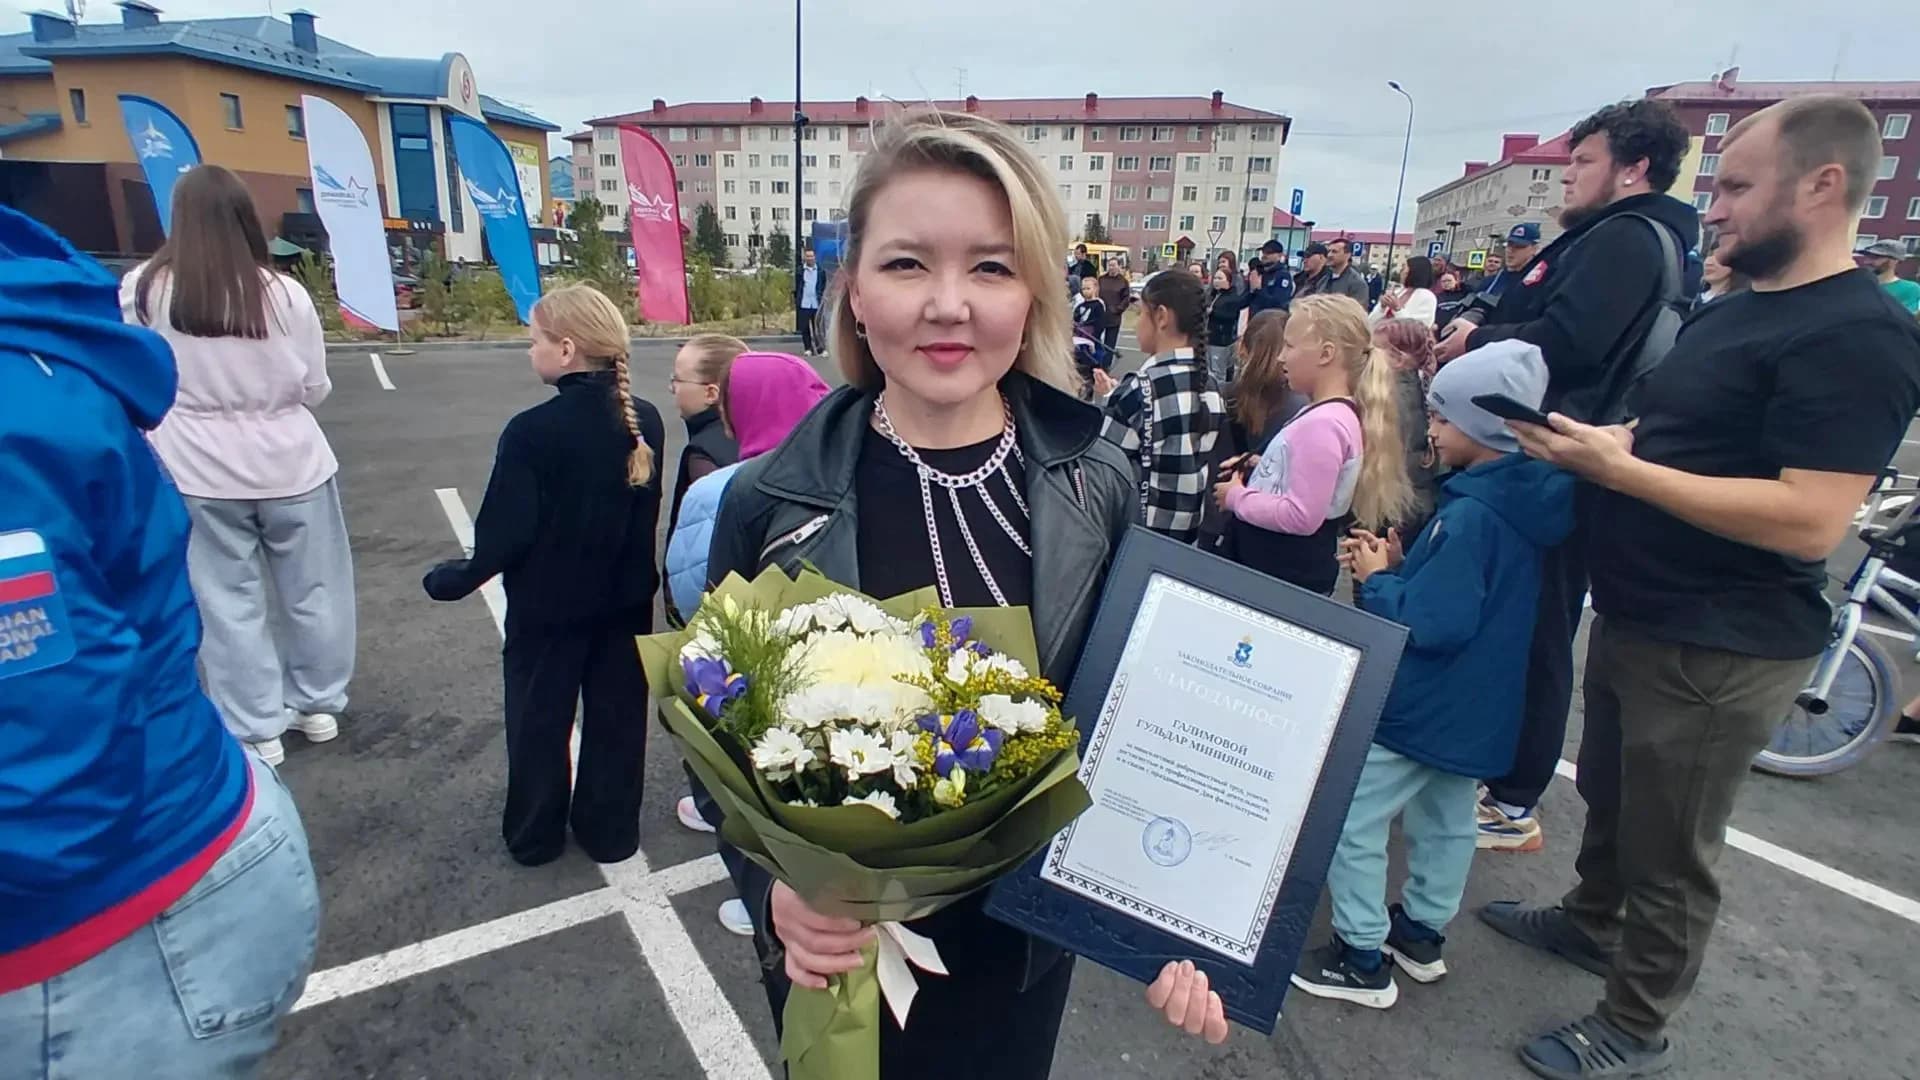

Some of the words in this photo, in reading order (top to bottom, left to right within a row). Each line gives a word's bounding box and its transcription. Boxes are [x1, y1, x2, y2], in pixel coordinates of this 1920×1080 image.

[1293, 191, 1301, 213] P
[1353, 242, 1361, 255] P
[1430, 242, 1441, 258] P
[1144, 414, 1153, 447] KARL
[1251, 679, 1293, 700] СОБРАНИЕ
[1135, 718, 1188, 747] ГУЛЬДАР
[1171, 717, 1249, 756] ГАЛИМОВОЙ
